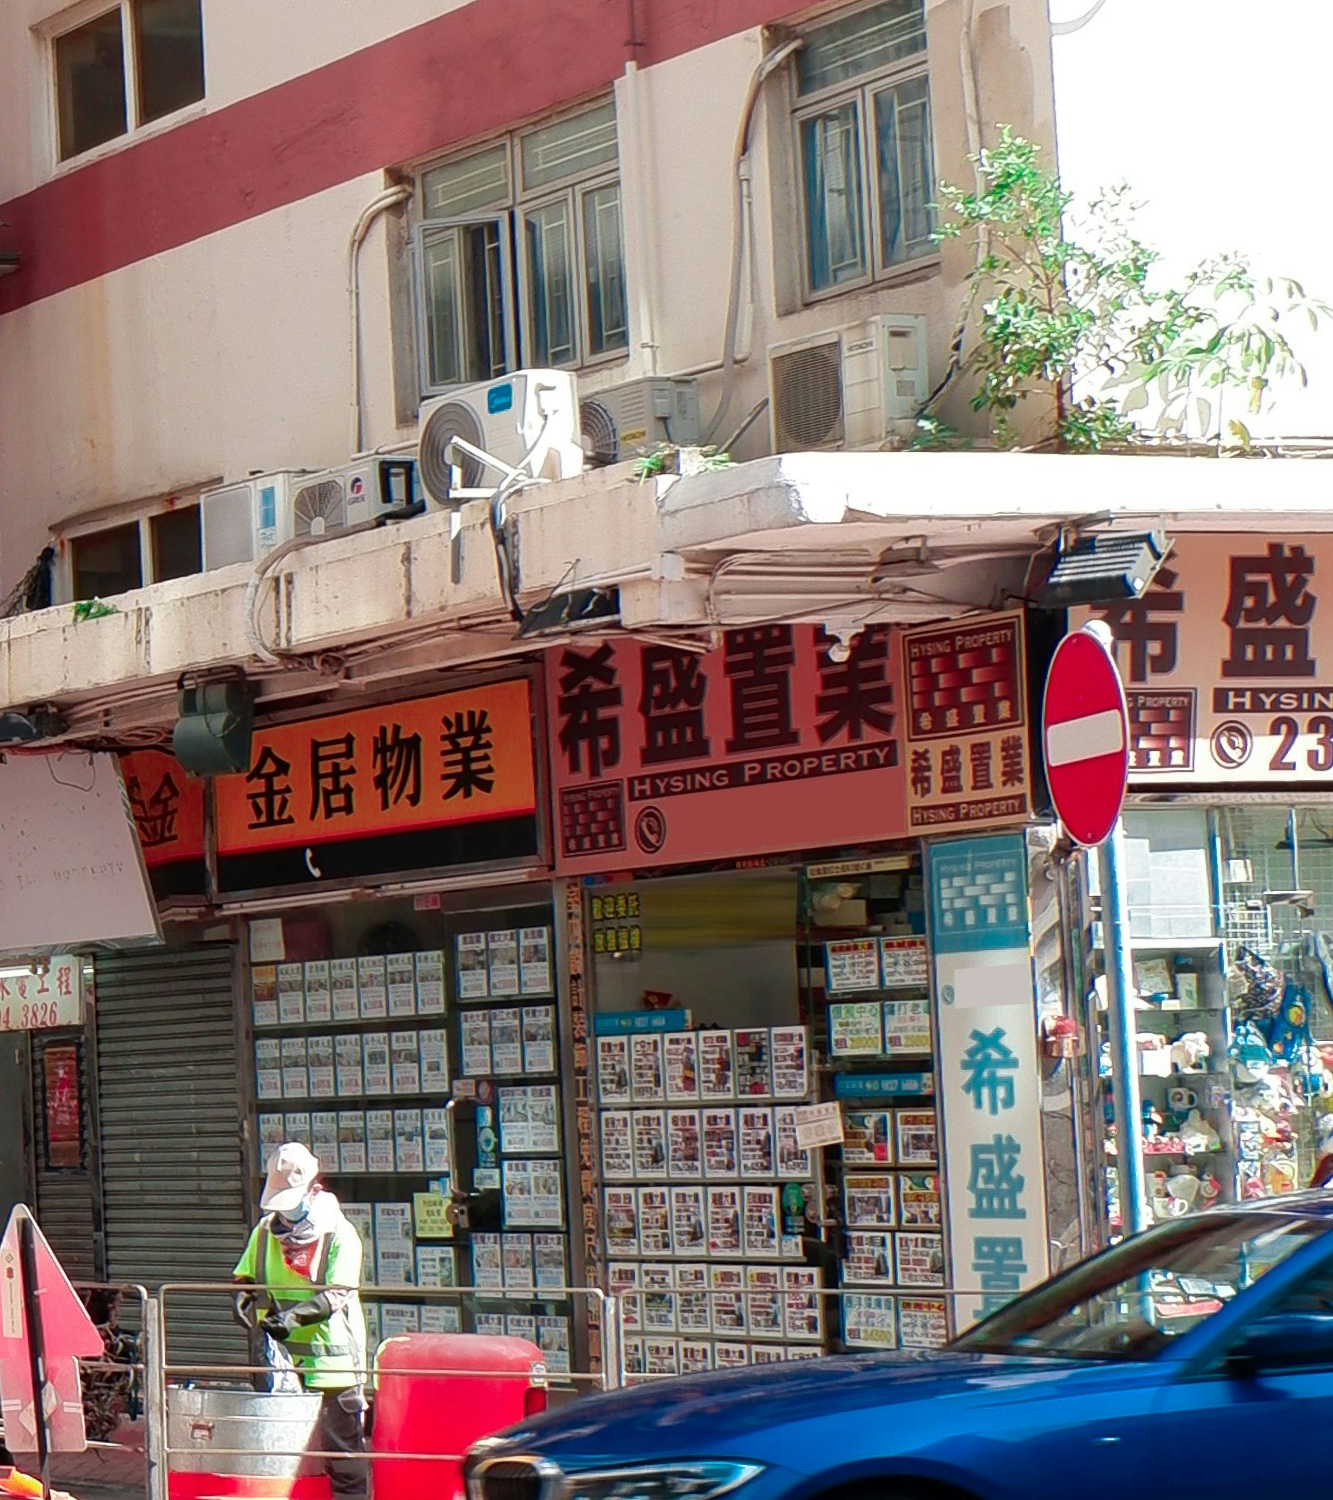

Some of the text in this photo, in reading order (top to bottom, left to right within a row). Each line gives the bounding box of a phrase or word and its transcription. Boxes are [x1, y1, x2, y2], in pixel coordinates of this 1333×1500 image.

[910, 629, 1014, 659] HYSING PROPERTY
[558, 622, 898, 778] 希盛置業
[245, 709, 496, 831] 金居物業
[634, 746, 891, 799] HYSING PROPERTY
[910, 734, 1025, 799] 希盛置業
[912, 799, 1022, 824] HYSING PROPERTY
[20, 1000, 59, 1028] 3826
